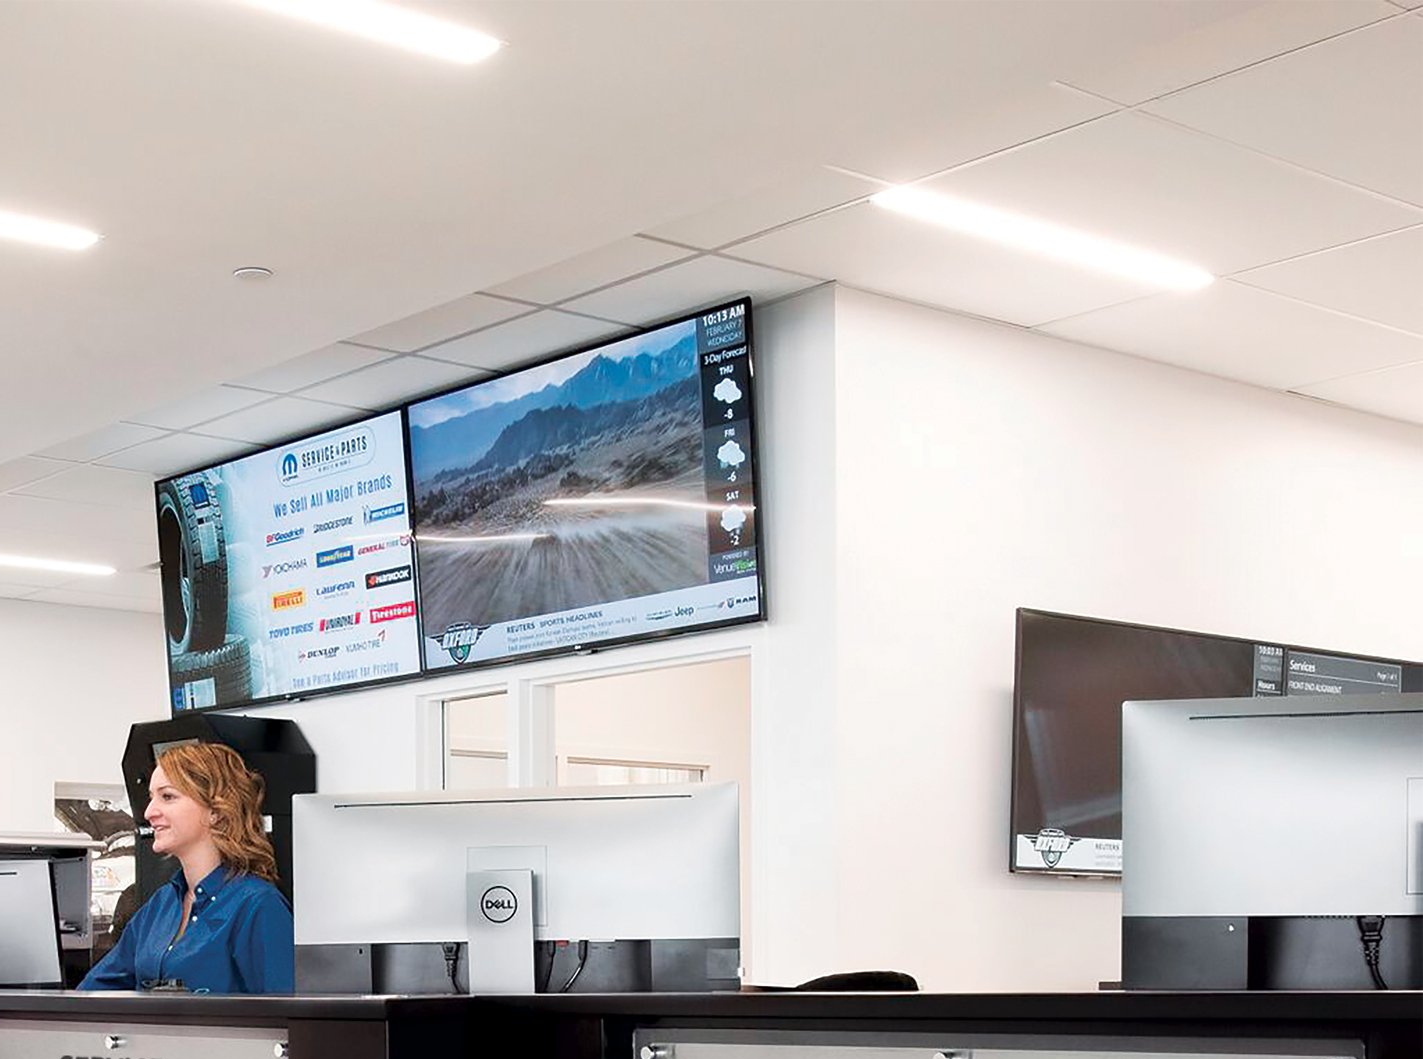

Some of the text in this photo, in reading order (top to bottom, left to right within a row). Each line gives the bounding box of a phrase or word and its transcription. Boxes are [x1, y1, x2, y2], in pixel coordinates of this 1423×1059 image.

[702, 304, 745, 326] 10:13 AM
[706, 321, 737, 337] FEBRUARY
[708, 332, 742, 346] WEDNESDAY
[704, 345, 747, 365] 3-Day Forecast
[719, 364, 734, 376] THU
[724, 408, 734, 419] -8
[724, 428, 735, 438] FRI
[301, 445, 335, 468] SERVICE
[340, 436, 368, 456] PARTS
[728, 471, 737, 482] -6
[273, 474, 392, 518] We Sell All Major Brands
[726, 490, 740, 501] SAT
[313, 515, 354, 534] BRIDGESTONE
[736, 595, 756, 604] RAM
[372, 605, 412, 622] Firestone
[674, 606, 694, 618] Jeep
[506, 623, 535, 634] REUTERS
[539, 617, 564, 628] SPORTS
[566, 610, 603, 624] HEADLINES
[290, 622, 314, 636] TIRES
[307, 646, 340, 659] DUNLOP
[1289, 659, 1316, 672] Services
[1258, 680, 1276, 690] Hours
[486, 900, 514, 910] DELL
